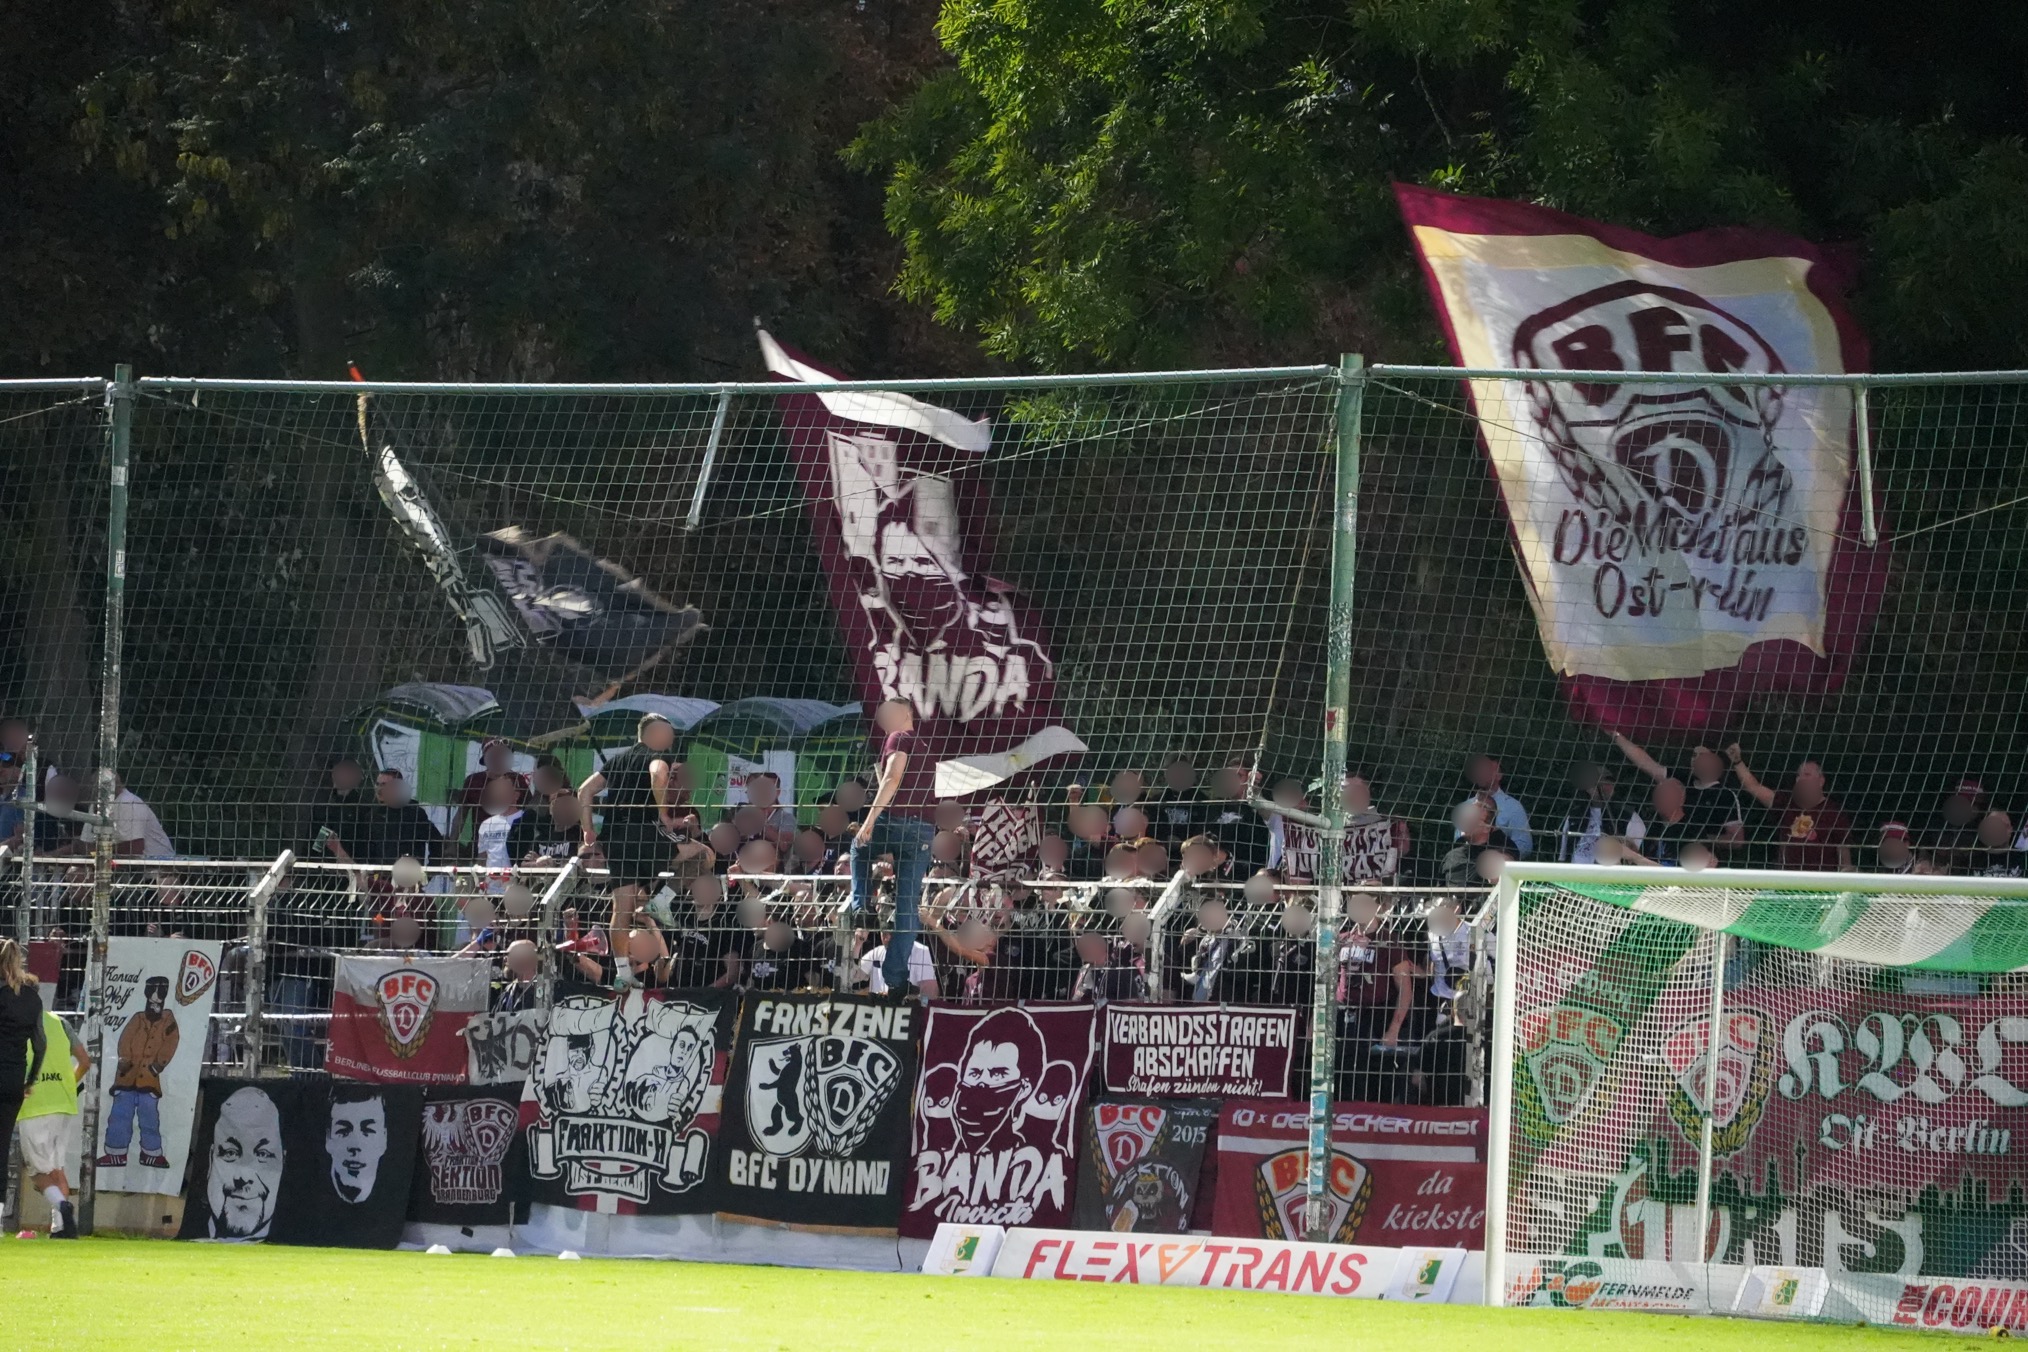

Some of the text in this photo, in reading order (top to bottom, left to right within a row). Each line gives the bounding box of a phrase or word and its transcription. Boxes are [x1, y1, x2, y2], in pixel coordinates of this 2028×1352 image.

[1553, 509, 1631, 566] Die
[1733, 527, 1809, 566] aus
[873, 650, 1031, 723] BANDA
[105, 965, 144, 984] Konrad
[188, 953, 213, 981] BFC
[104, 985, 135, 1010] Wolf
[384, 975, 433, 1003] BFC
[754, 1000, 912, 1040] FANSZENE
[1110, 1012, 1289, 1048] VERBANDSSTRAFEN
[1521, 1009, 1618, 1058] BFC
[820, 1038, 893, 1085] BFC
[1133, 1046, 1255, 1078] ABSCHAFFEN
[1126, 1074, 1263, 1097] Strafen zünden nicht!
[469, 1105, 513, 1128] BFC
[1100, 1105, 1162, 1133] BFC
[1232, 1109, 1255, 1126] 10
[1257, 1114, 1267, 1124] x
[1172, 1124, 1208, 1149] 2015
[431, 1165, 500, 1191] SEKTION
[729, 1149, 891, 1196] BFC DYNAMO
[908, 1146, 1067, 1212] BANDA
[1271, 1153, 1356, 1196] BC
[1417, 1170, 1454, 1195] da
[934, 1194, 1034, 1225] Invicta
[1382, 1203, 1485, 1230] kiekste
[1023, 1239, 1368, 1295] FLEX TRANS
